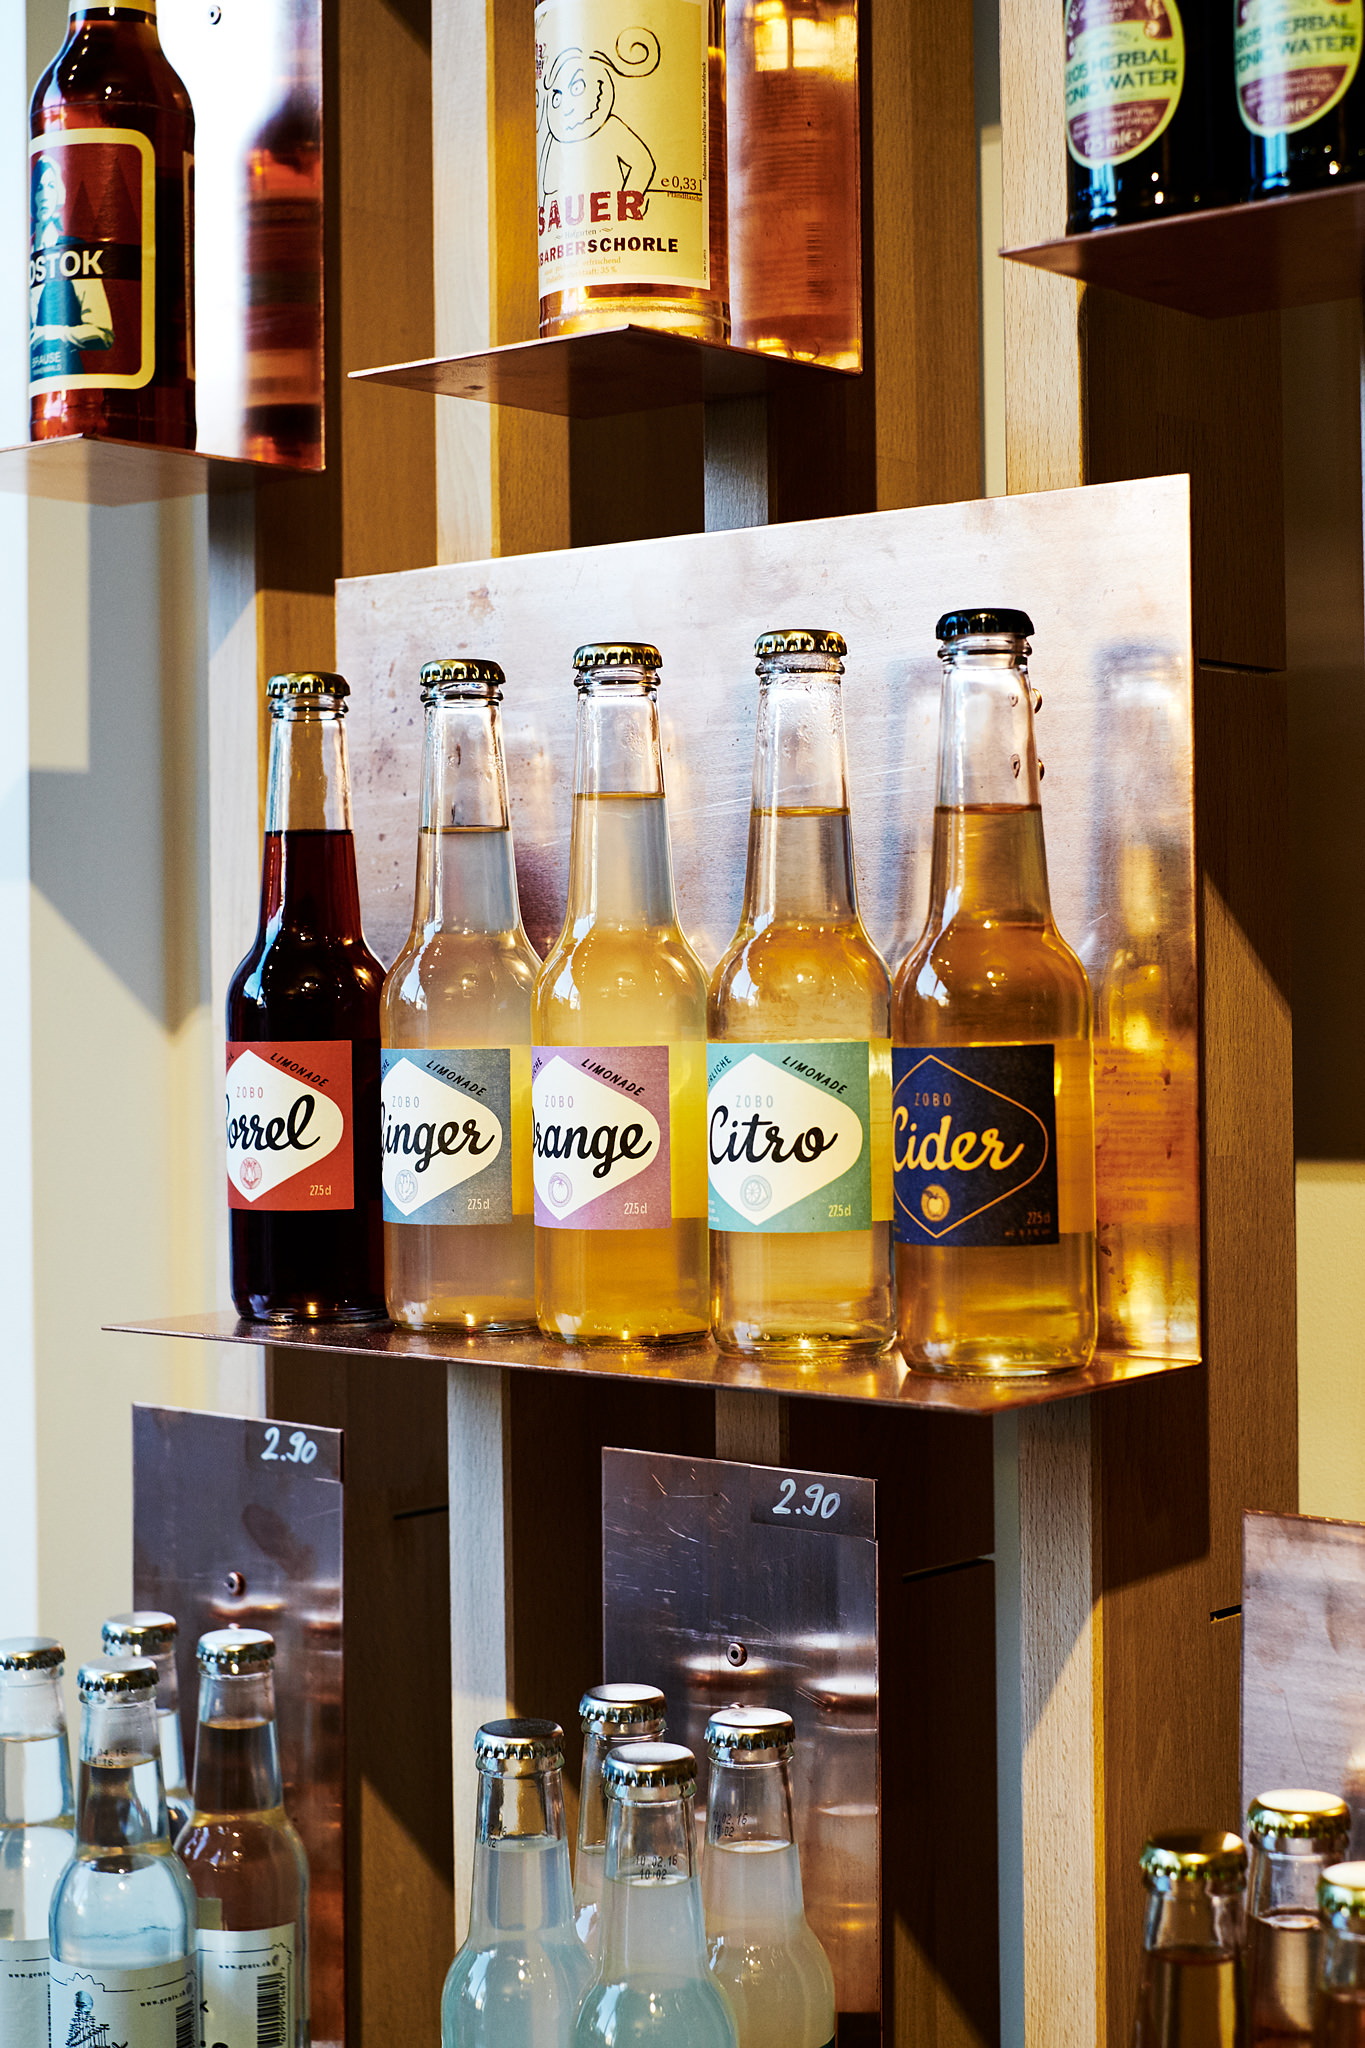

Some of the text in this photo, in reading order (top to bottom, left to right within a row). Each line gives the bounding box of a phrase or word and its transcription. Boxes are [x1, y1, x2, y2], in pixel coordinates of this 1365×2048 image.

[1091, 48, 1177, 72] HERBAL
[1279, 35, 1356, 56] WATER
[1102, 69, 1178, 90] WATER
[671, 175, 697, 191] 0,33
[538, 190, 645, 236] SAUER
[270, 1052, 329, 1087] LIMONADE
[426, 1060, 487, 1097] LIMONADE
[581, 1058, 646, 1097] LIMONADE
[781, 1055, 849, 1095] LIMONADE
[236, 1086, 264, 1099] ZOBO
[392, 1095, 420, 1109] ZOBO
[544, 1095, 574, 1109] ZOBO
[735, 1094, 774, 1109] ZOBO
[914, 1092, 952, 1107] ZOBO
[226, 1093, 321, 1151] orrel
[381, 1101, 495, 1173] inger
[709, 1105, 838, 1165] Citro
[892, 1105, 1025, 1172] Cider
[532, 1107, 653, 1179] range
[260, 1426, 318, 1465] 2.90
[772, 1478, 841, 1519] 2.90
[635, 1853, 678, 1868] 10.02.16
[640, 1868, 668, 1880] 10:02
